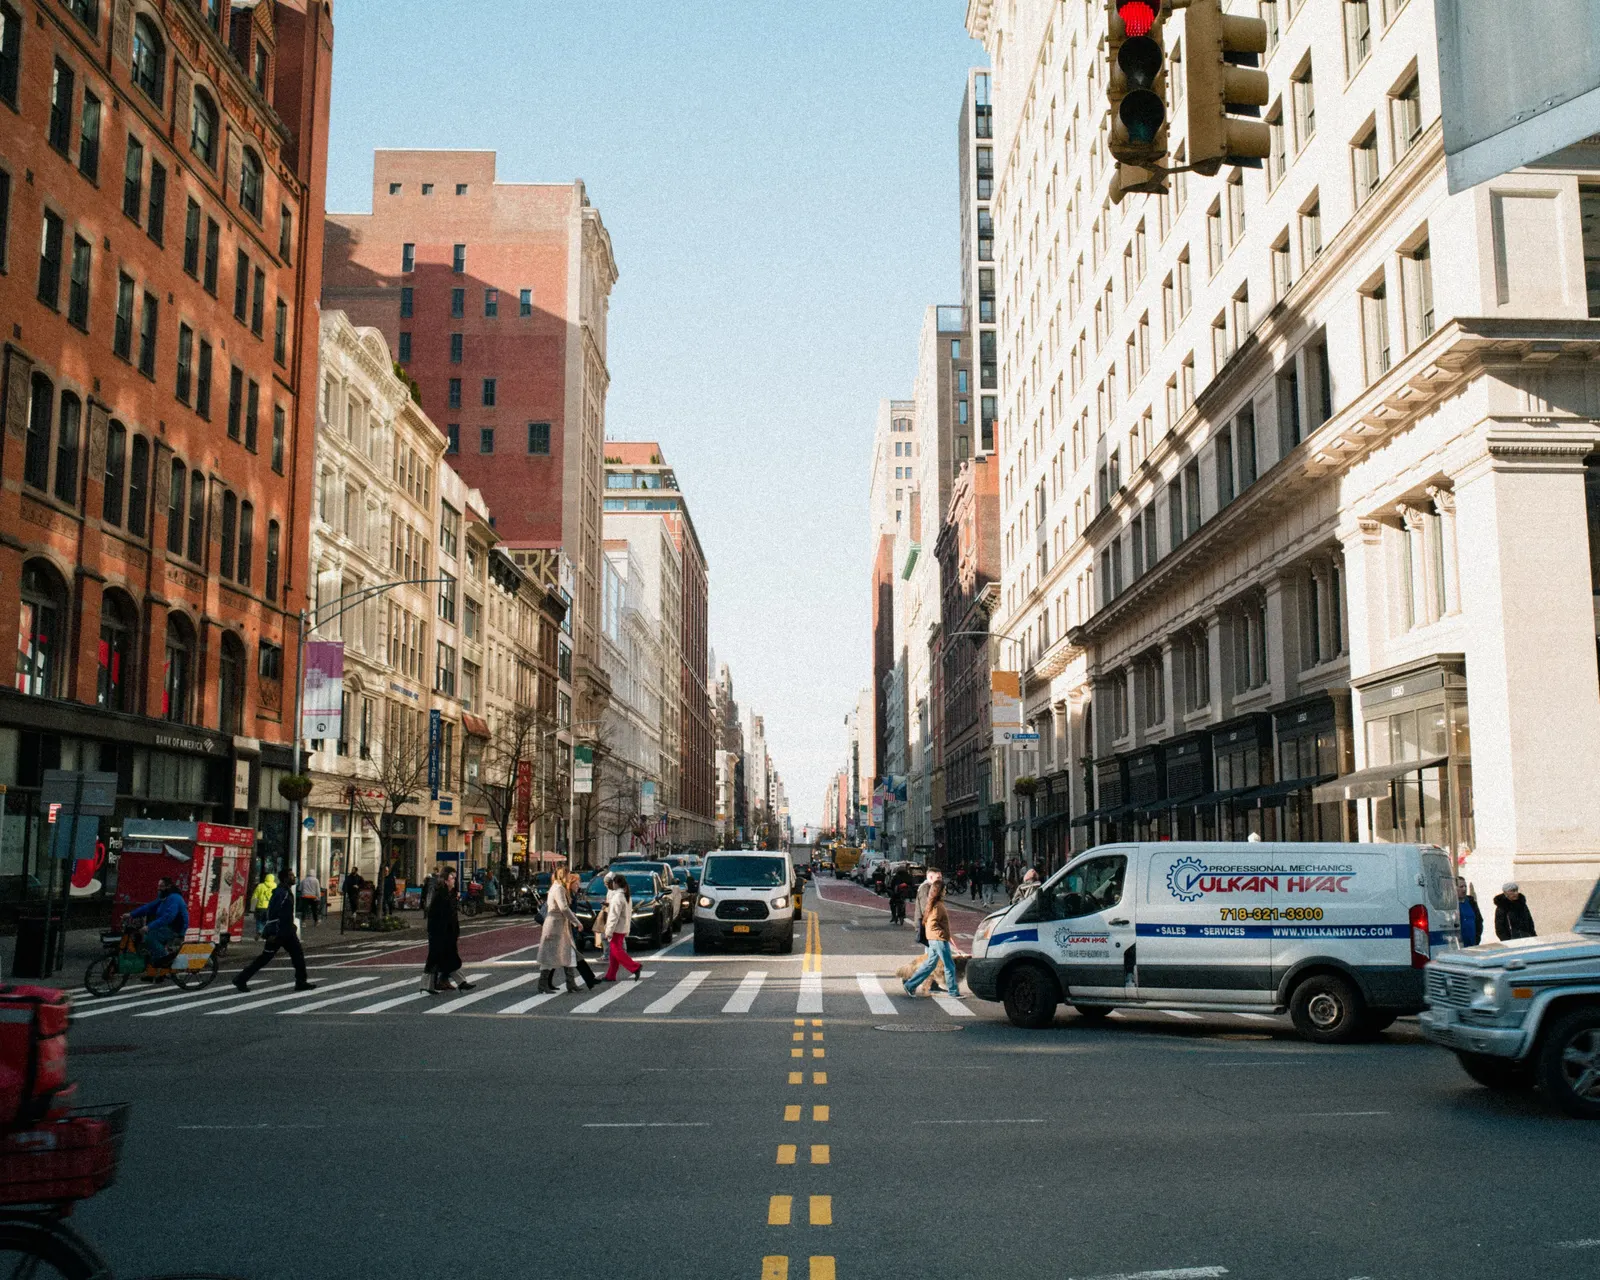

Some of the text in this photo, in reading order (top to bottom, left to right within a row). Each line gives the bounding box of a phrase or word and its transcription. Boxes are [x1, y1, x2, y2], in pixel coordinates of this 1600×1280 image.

[156, 735, 203, 750] BANK OF AMERICA
[1289, 864, 1353, 872] MECHANICS
[1186, 873, 1352, 892] VULKAN HVAC
[1220, 908, 1323, 921] 718-321-3300
[1161, 927, 1393, 937] SALES SERVICES WWW.VULKANHVAC.COM
